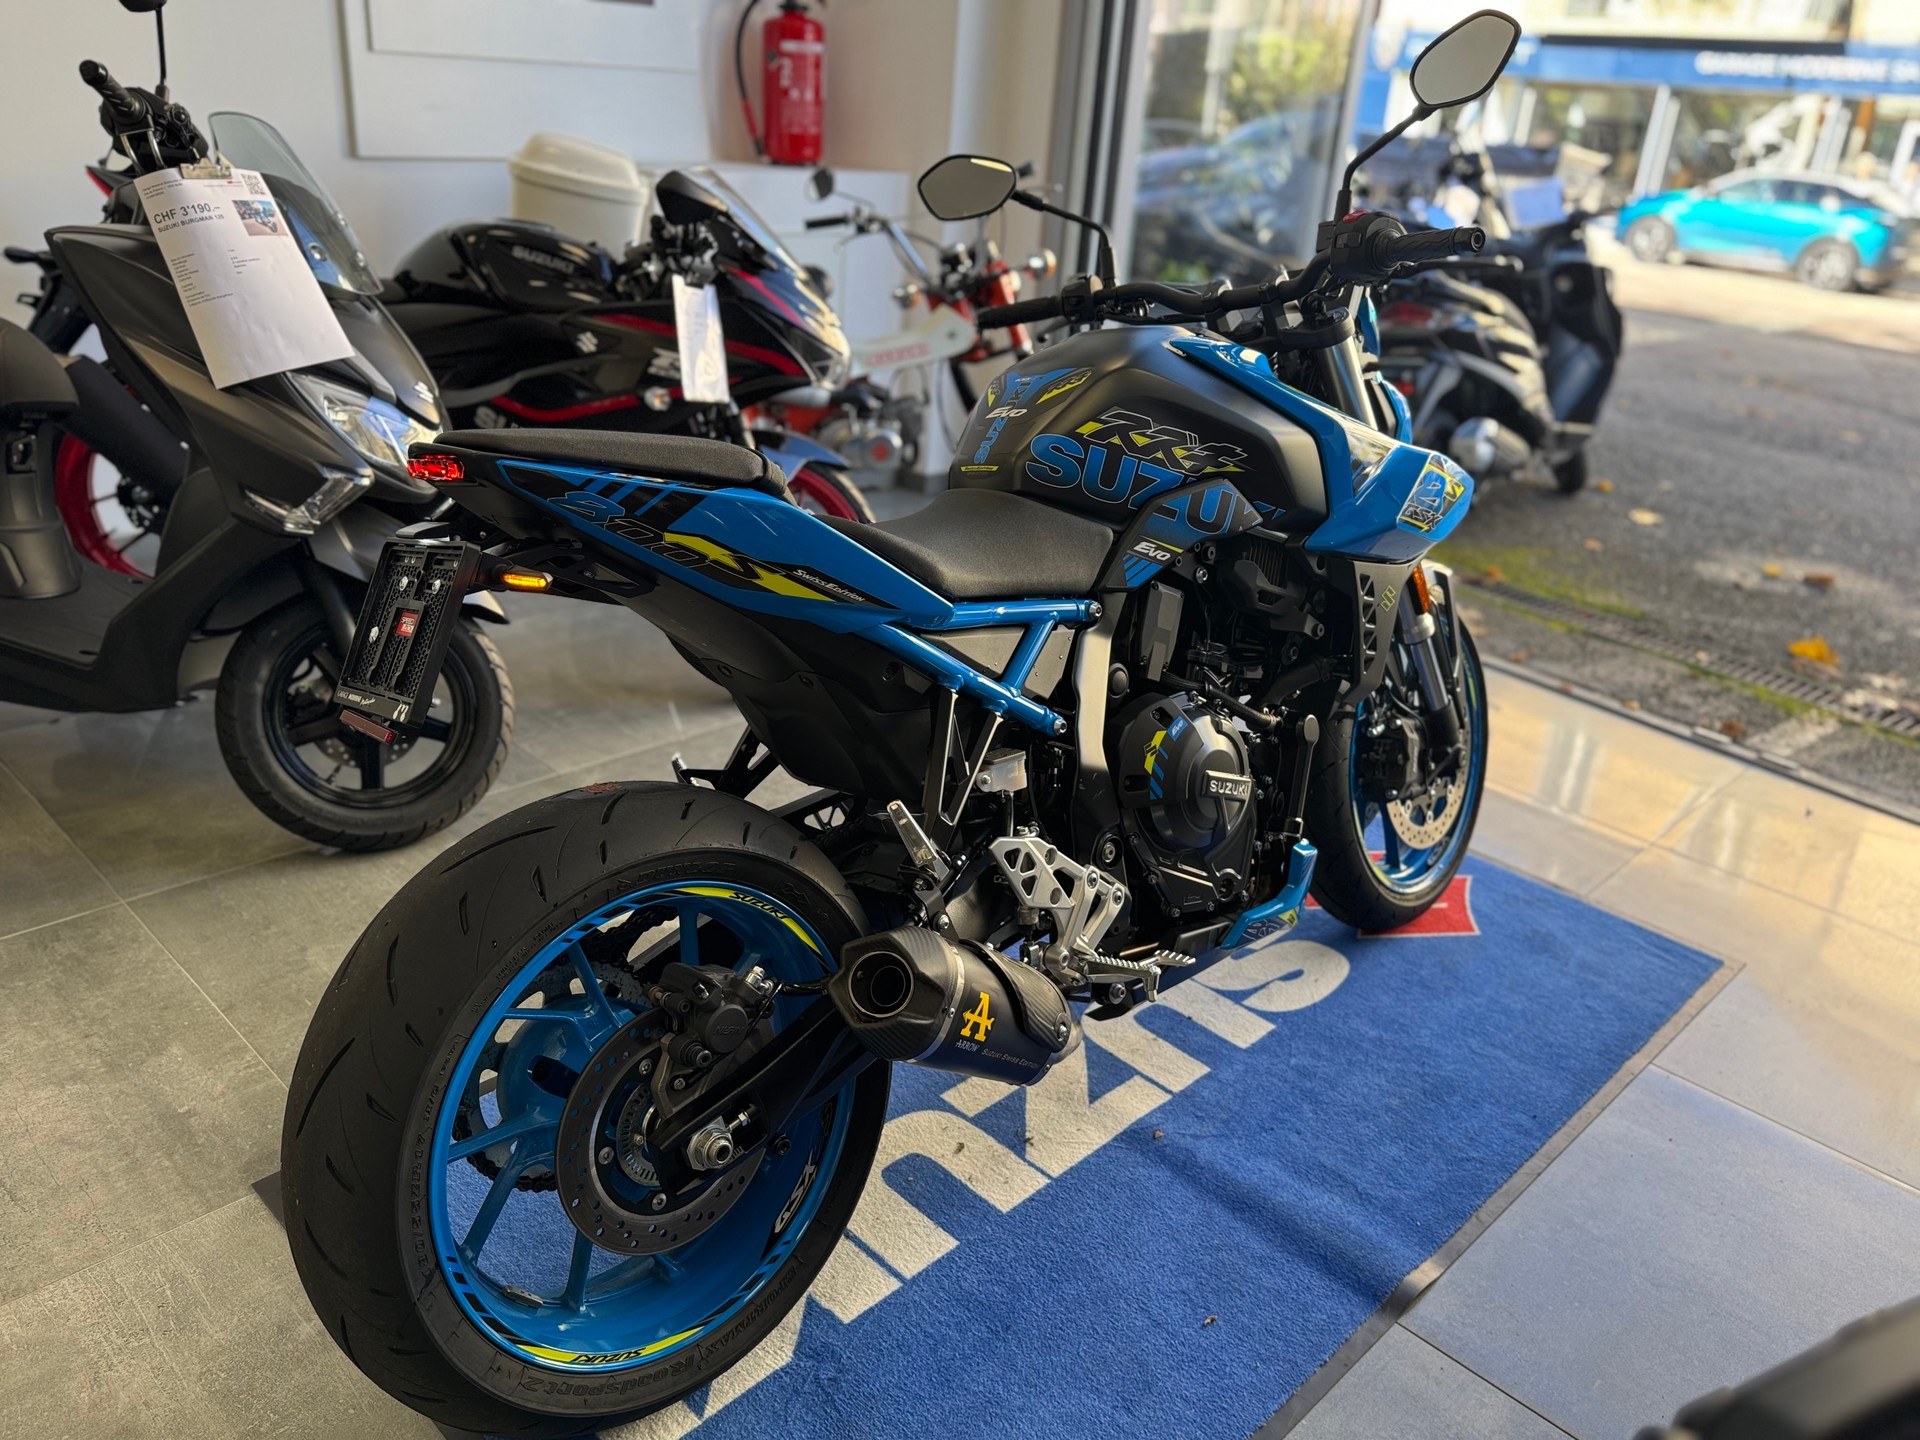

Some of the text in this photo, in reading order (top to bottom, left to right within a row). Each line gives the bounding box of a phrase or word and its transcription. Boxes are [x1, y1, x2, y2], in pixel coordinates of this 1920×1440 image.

[154, 208, 177, 225] CHF
[158, 221, 181, 233] SUZUKI
[181, 215, 213, 227] BURGMAN
[511, 245, 576, 273] SUZUKI
[985, 405, 1028, 419] Evo
[1133, 541, 1171, 560] Evo
[1171, 720, 1184, 737] Evo
[1209, 780, 1251, 797] SUZUKI
[729, 890, 788, 920] SUZUKI
[955, 1039, 981, 1053] ARROW
[570, 1347, 648, 1364] SUZUKI
